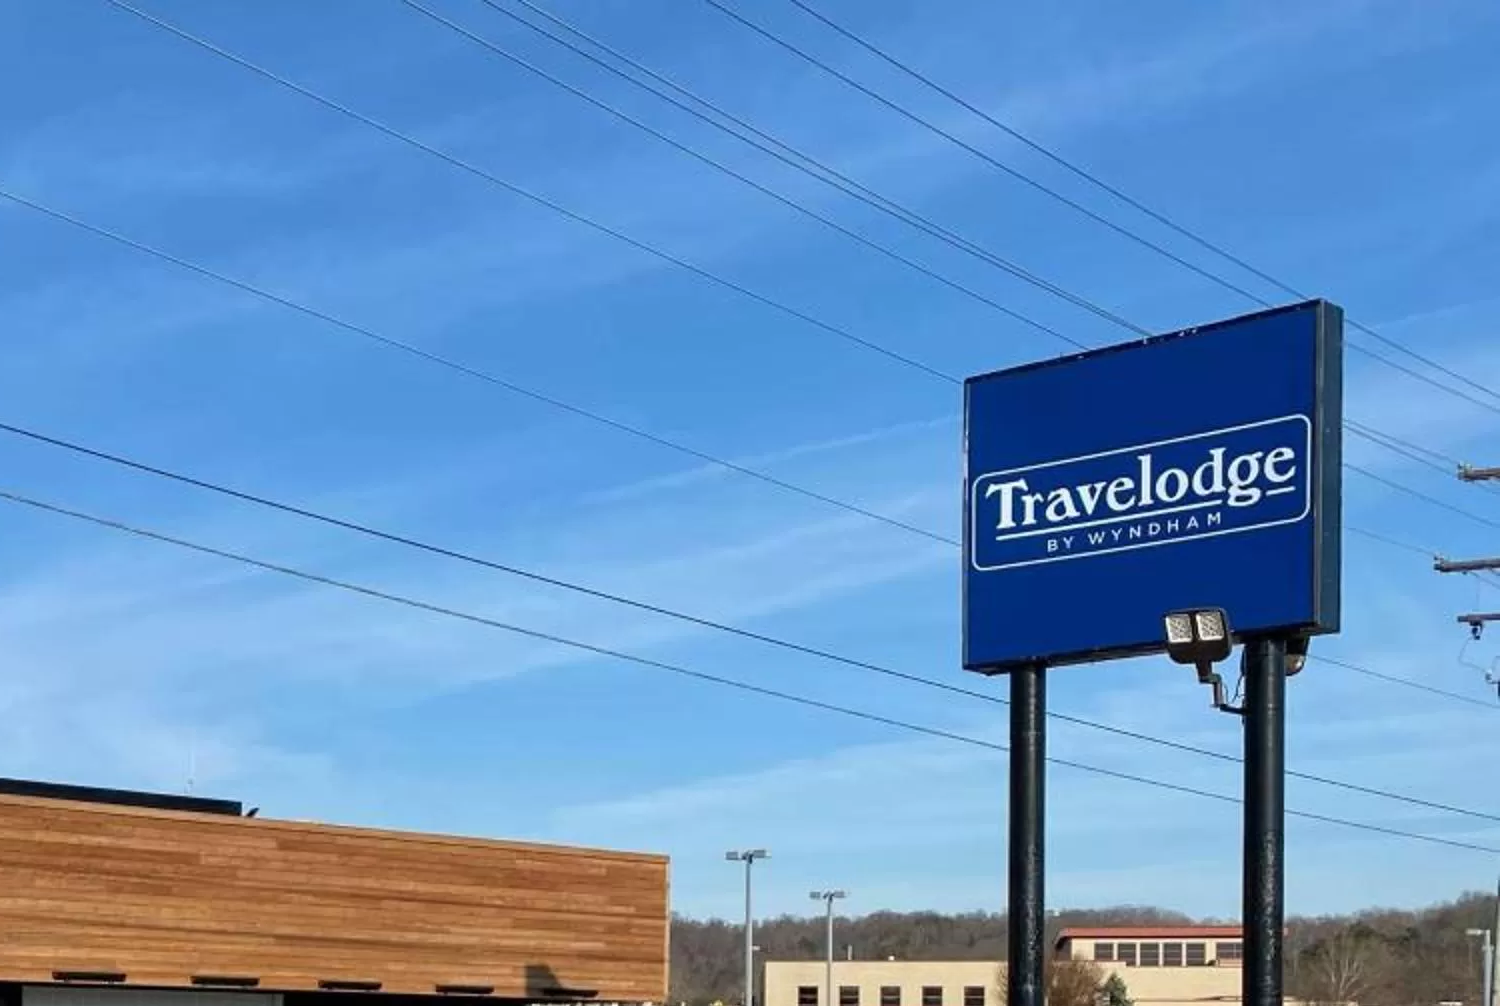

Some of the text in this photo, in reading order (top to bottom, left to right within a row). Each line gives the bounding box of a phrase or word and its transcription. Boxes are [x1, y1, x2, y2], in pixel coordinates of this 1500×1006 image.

[985, 446, 1297, 530] Travelodge
[1047, 511, 1222, 553] BY WYNDHAM
